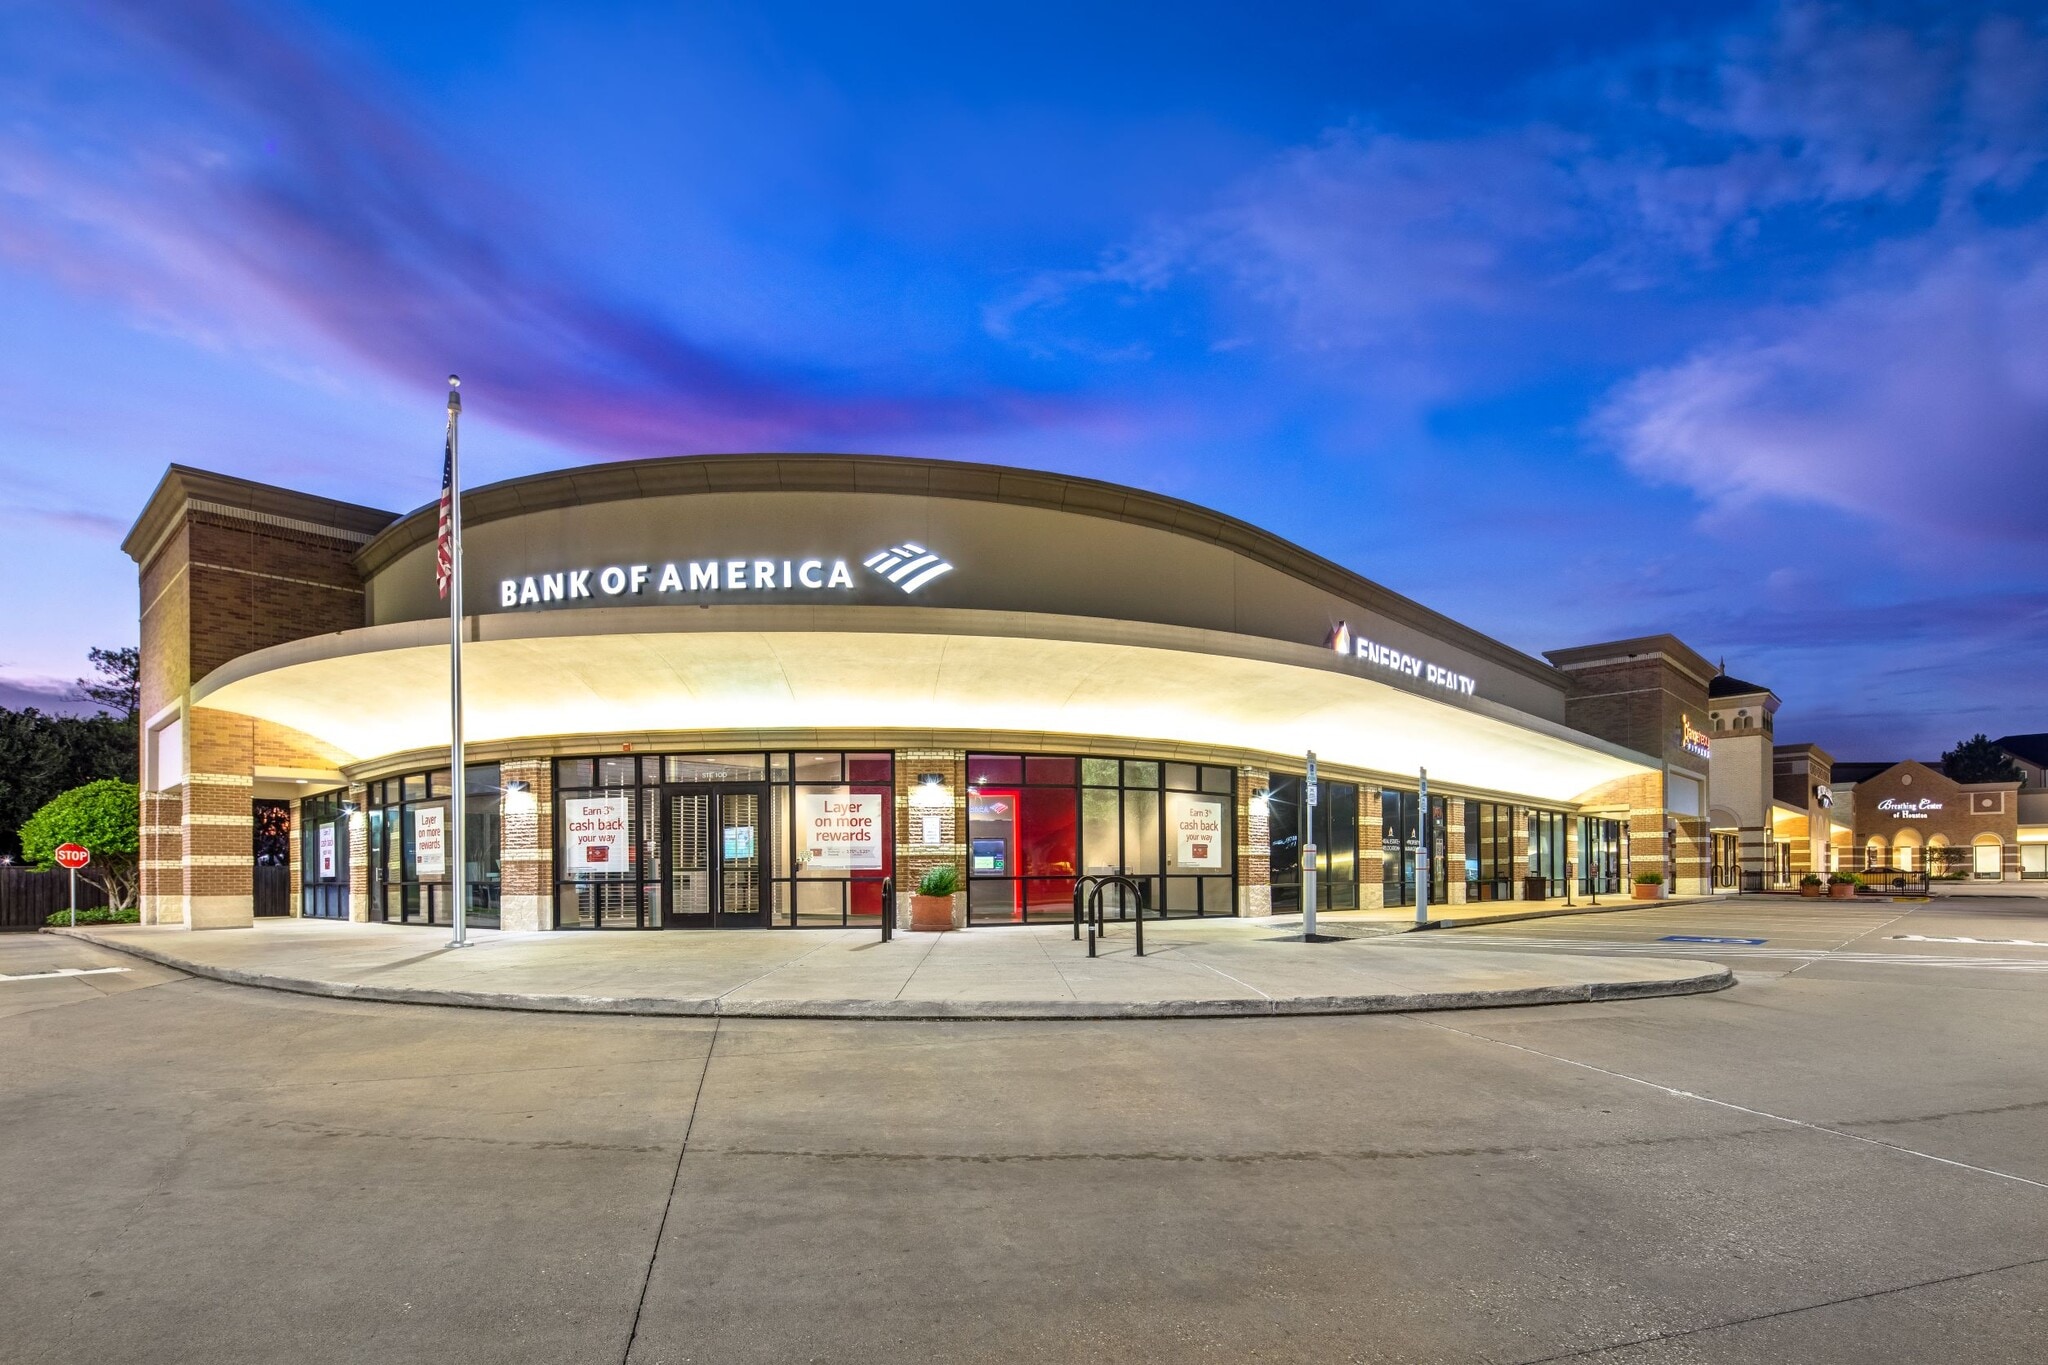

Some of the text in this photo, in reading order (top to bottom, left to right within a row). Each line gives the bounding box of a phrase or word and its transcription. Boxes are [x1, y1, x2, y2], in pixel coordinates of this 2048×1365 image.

[501, 560, 855, 607] BANK OF AMERICA
[825, 800, 862, 816] Layer
[1878, 798, 1943, 811] Breathing Center
[582, 806, 602, 816] Earn
[1189, 808, 1204, 817] Earn
[1892, 810, 1928, 819] of Houston
[421, 814, 437, 828] Layer
[569, 817, 624, 832] cash back
[815, 817, 872, 827] on more
[1179, 819, 1219, 832] cash back
[418, 828, 441, 839] on more
[816, 828, 871, 841] rewards
[1185, 833, 1213, 844] your way
[418, 837, 441, 850] rewards
[578, 834, 616, 846] your way
[58, 850, 88, 861] STOP
